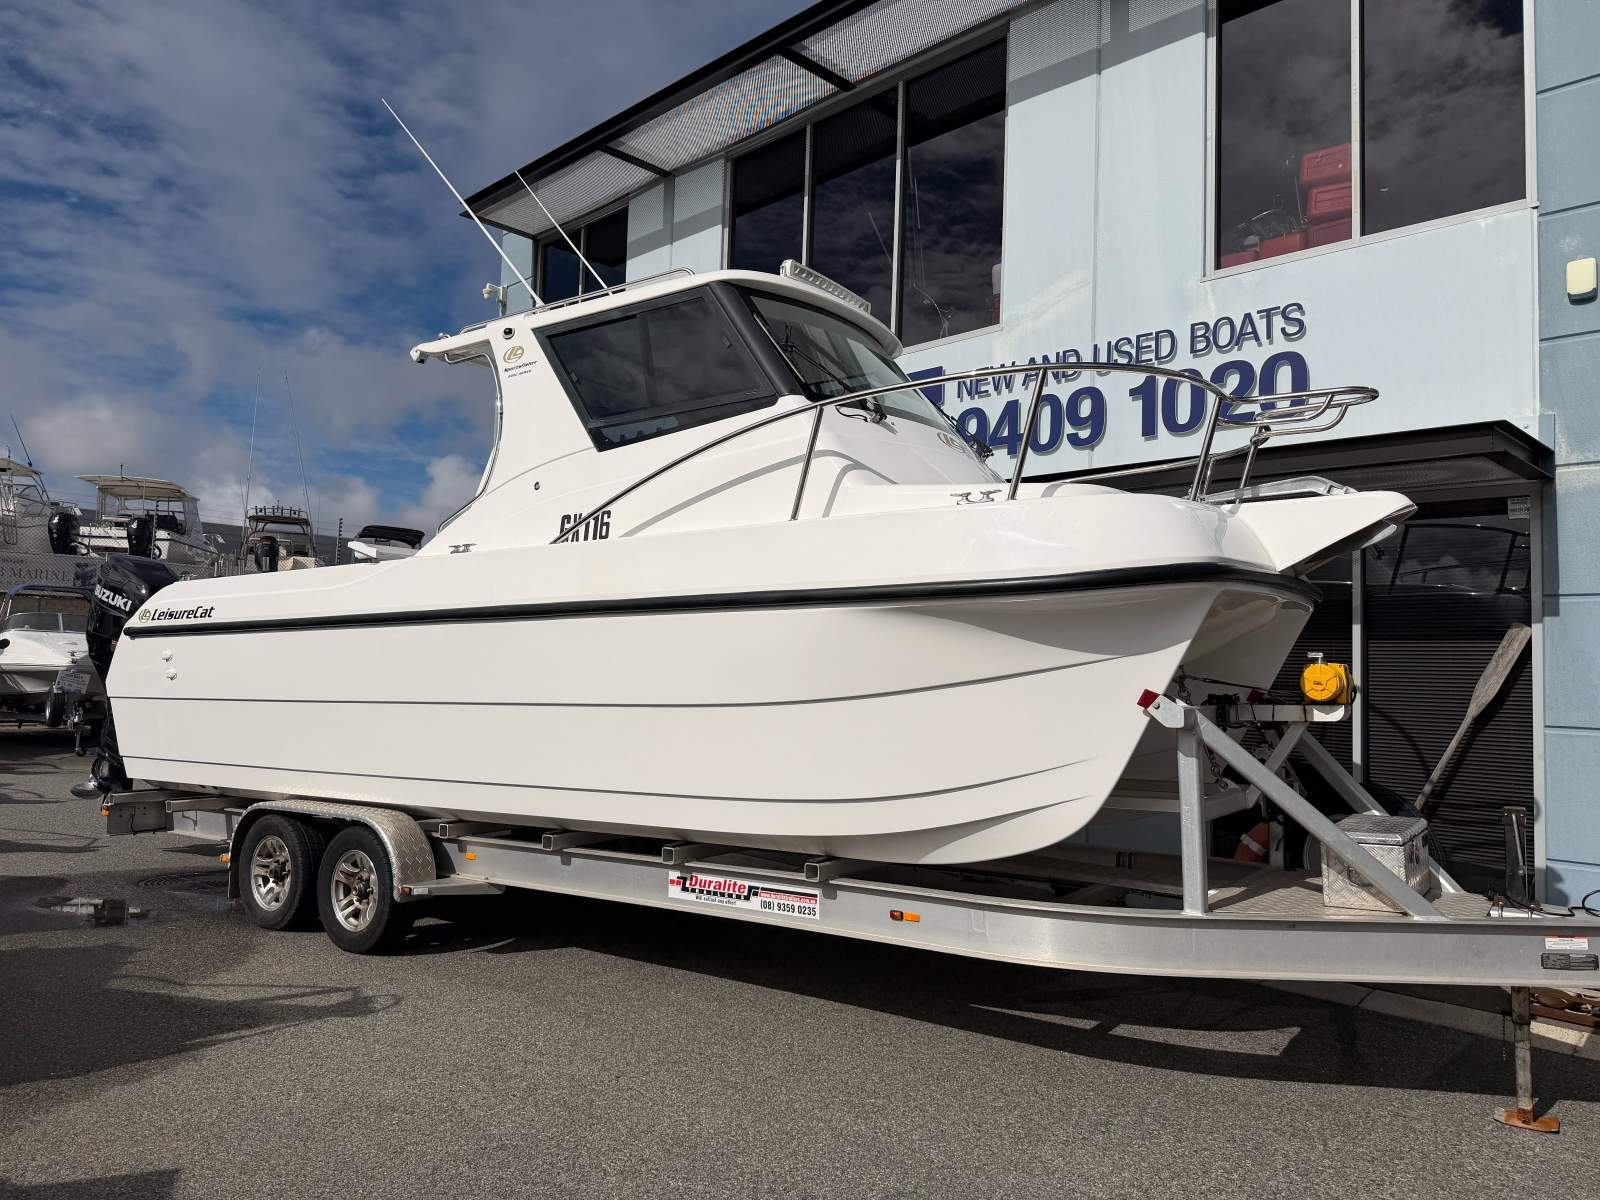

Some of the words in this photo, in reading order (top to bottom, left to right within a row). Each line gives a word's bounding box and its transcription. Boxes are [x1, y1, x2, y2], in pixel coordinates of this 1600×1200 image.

[956, 358, 1019, 399] NEW
[1022, 347, 1083, 388] AND
[1092, 328, 1178, 371] USED
[1190, 302, 1306, 356] BOATS
[957, 385, 1108, 457] 9409
[1128, 350, 1311, 439] 1020
[94, 584, 132, 612] SUZUKI
[151, 606, 215, 622] LeisureCat
[689, 873, 746, 895] Duralite
[761, 900, 774, 911] (08)
[777, 902, 796, 914] 9359
[798, 905, 817, 917] 0235
